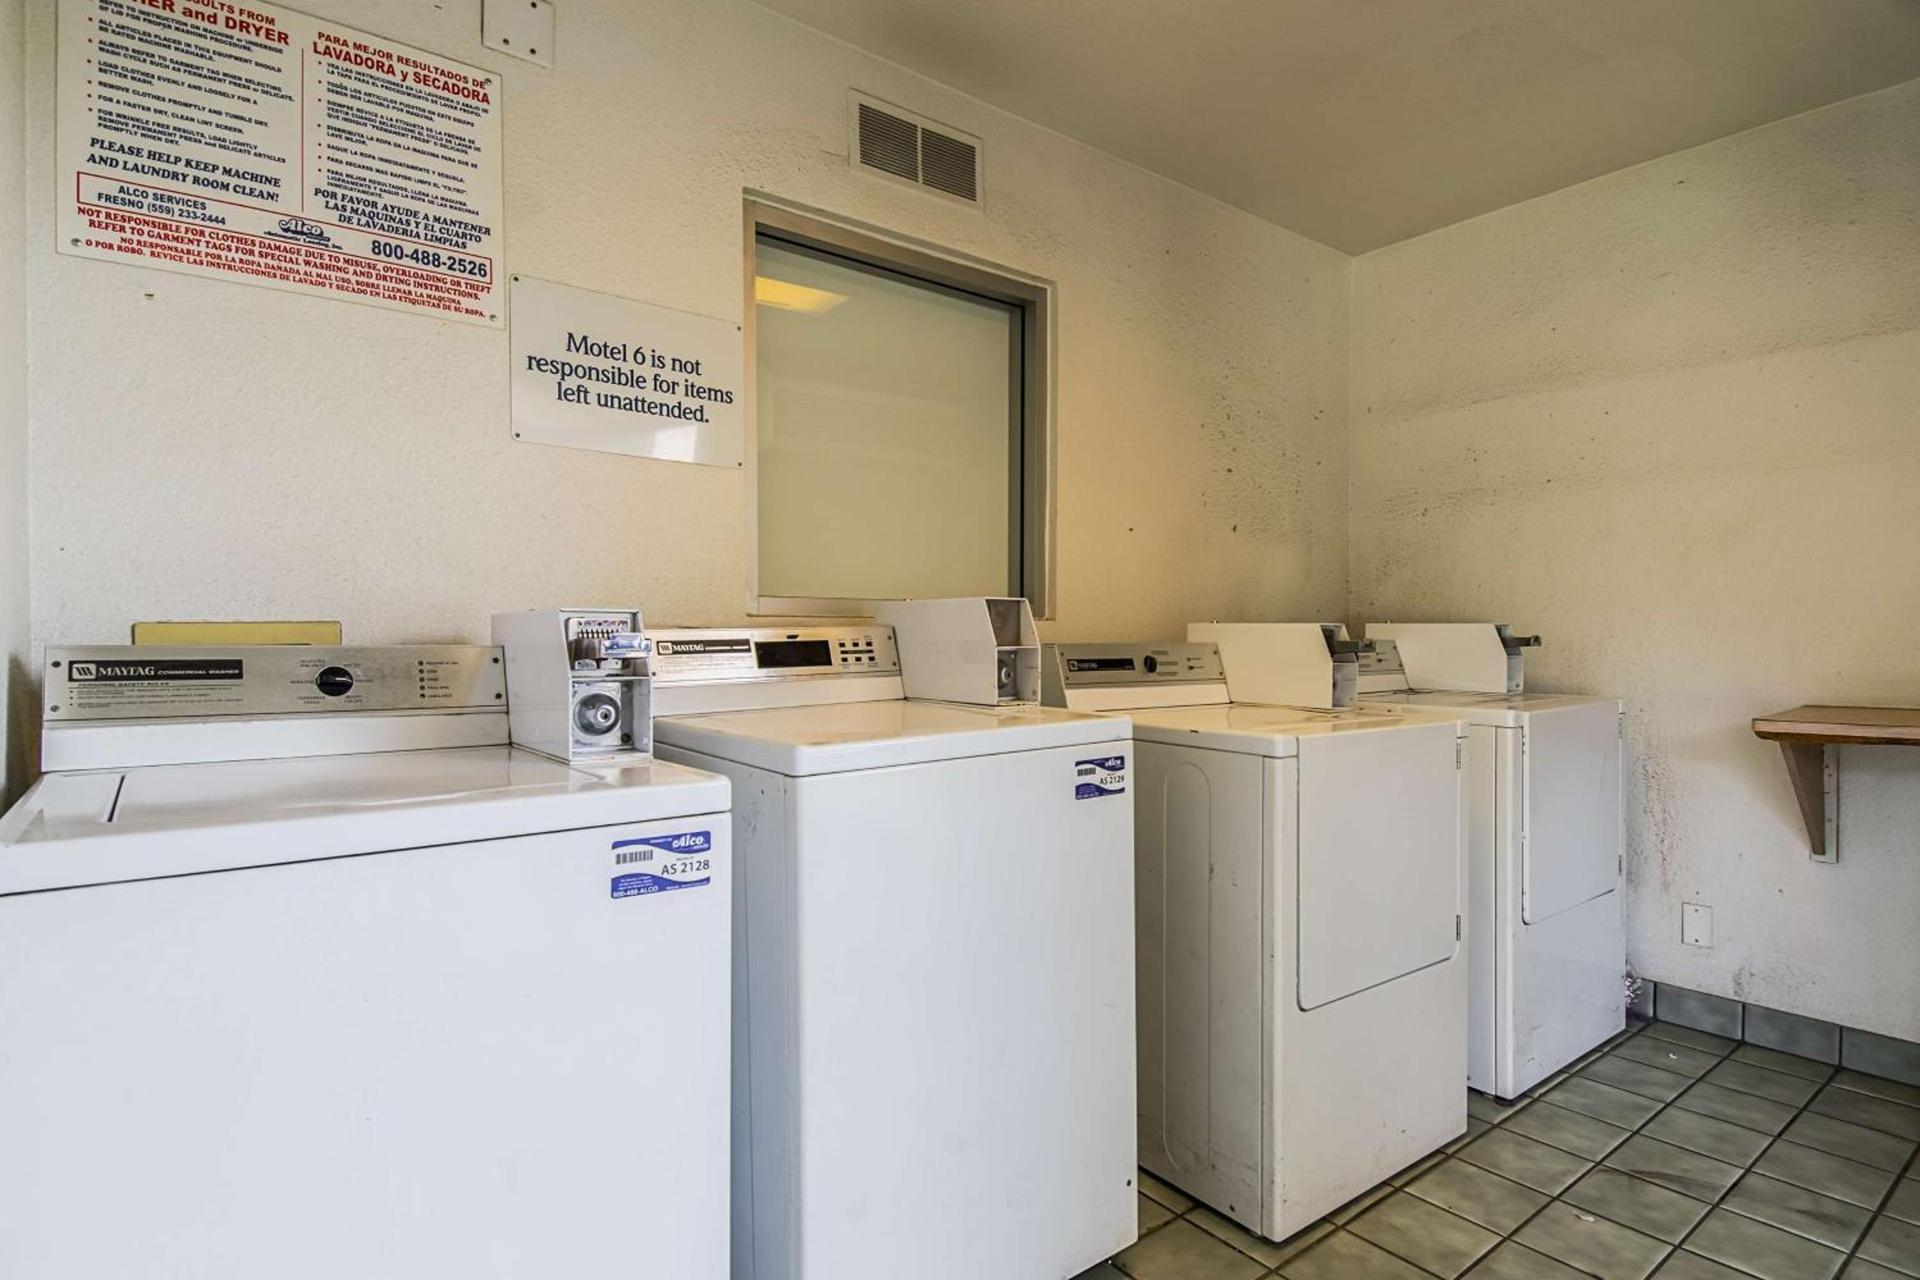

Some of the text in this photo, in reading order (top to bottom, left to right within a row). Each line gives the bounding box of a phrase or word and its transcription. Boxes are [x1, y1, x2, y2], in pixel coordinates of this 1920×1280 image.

[181, 1, 217, 25] and
[224, 15, 288, 46] DRYER
[238, 6, 275, 26] FROM
[313, 41, 489, 104] LAVADORA y SECADORA
[318, 30, 486, 90] PARA MEJOR RESULTADOS DE
[87, 151, 278, 204] AND LAUNDRY ROOM CLEAN!
[90, 135, 280, 189] PLEASE HELP KEEP MACHINE
[97, 191, 225, 227] FRESNO (559) 233-2444
[118, 184, 206, 211] ALCO SERVICES
[314, 187, 490, 236] POR FAVOR AYUDE A MANTENER
[278, 215, 322, 238] Alco
[324, 200, 481, 243] LAS MAQUINAS Y EL CUARTO
[338, 213, 467, 250] DE LAVADERIA LIMPIAS
[77, 206, 102, 219] NOT
[104, 211, 181, 234] RESPONSIBLE
[184, 227, 205, 239] FOR
[208, 231, 256, 248] CLOTHES
[258, 241, 302, 257] DAMAGE
[304, 250, 325, 262] DUE
[327, 255, 340, 264] TO
[382, 266, 447, 285] OVERLOADING
[449, 279, 461, 288] OR
[464, 281, 490, 293] THEFT
[88, 218, 126, 234] REFER
[129, 226, 144, 237] TO
[147, 229, 201, 248] GARMENT
[204, 240, 232, 253] TAGS
[234, 246, 255, 258] FOR
[257, 250, 300, 266] SPECIAL
[302, 259, 349, 275] WASHING
[352, 268, 373, 280] AND
[375, 273, 411, 287] DRYING
[371, 239, 487, 277] 800-488-2526
[566, 332, 702, 376] Motel 6 is not
[527, 355, 733, 404] responsible for items
[556, 381, 710, 423] left unattended.
[672, 643, 704, 652] MAYTAG
[99, 666, 155, 676] MAYTAG
[672, 834, 704, 849] Alco
[661, 859, 710, 876] AS 2128
